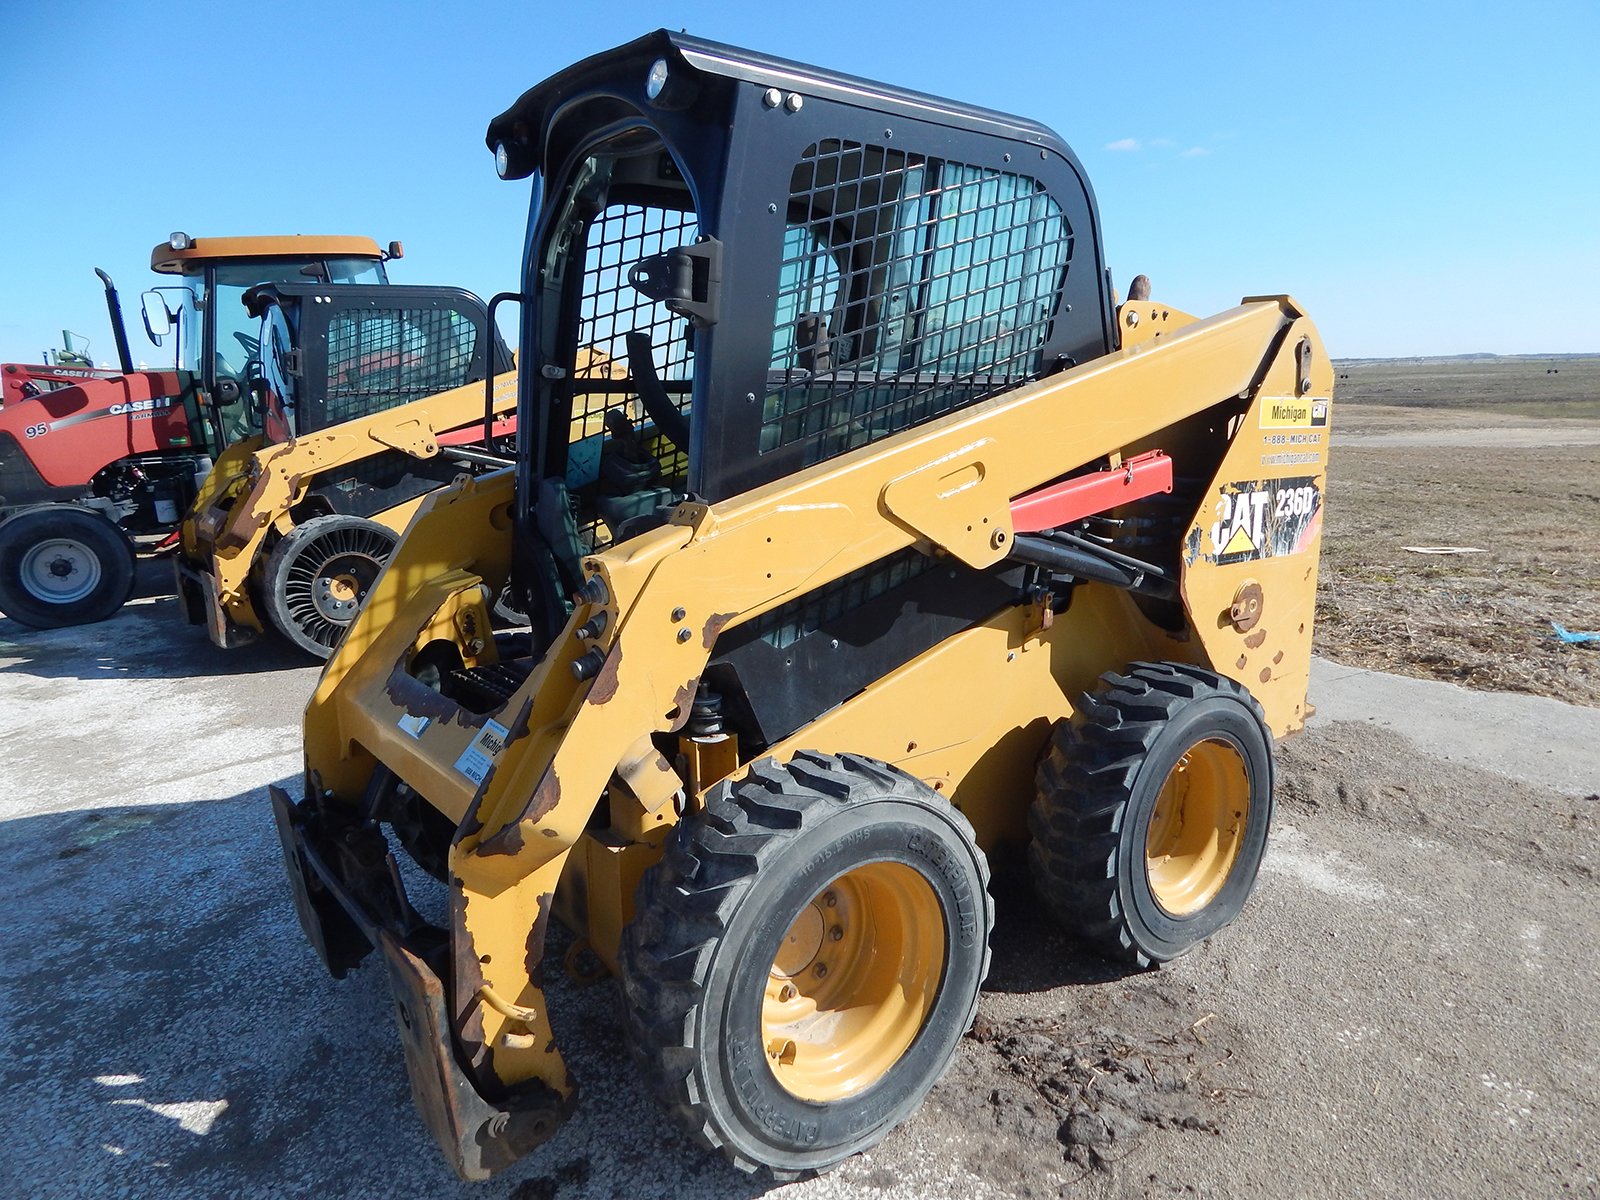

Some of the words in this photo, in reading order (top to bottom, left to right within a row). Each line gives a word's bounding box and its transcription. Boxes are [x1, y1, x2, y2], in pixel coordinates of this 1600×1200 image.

[109, 399, 154, 415] CASE
[1271, 405, 1307, 422] Michigan
[25, 423, 47, 439] 95
